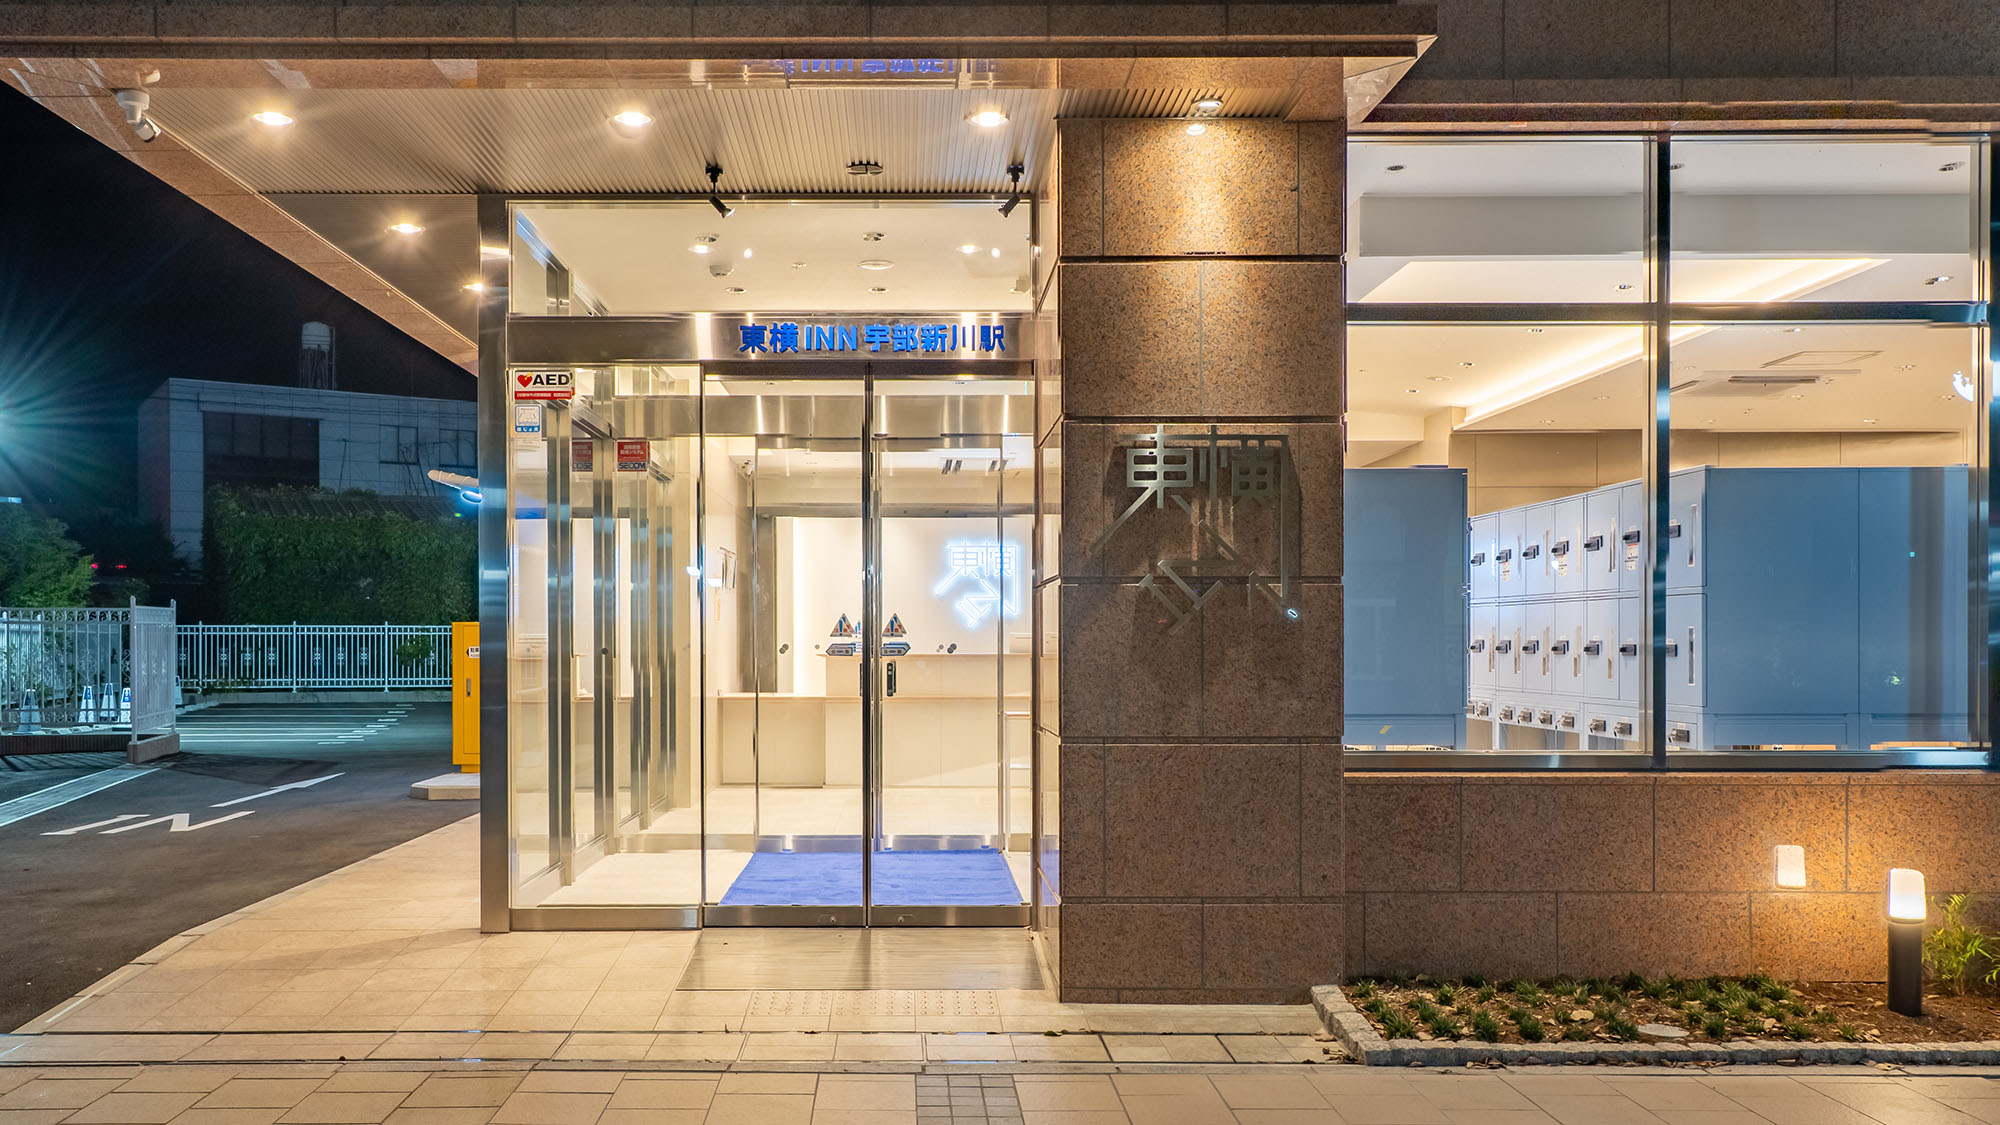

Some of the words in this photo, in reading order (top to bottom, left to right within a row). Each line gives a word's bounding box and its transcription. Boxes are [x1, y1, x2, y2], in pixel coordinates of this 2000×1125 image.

[805, 325, 858, 352] INN
[863, 322, 1006, 354] 宇部新川駅
[532, 374, 570, 386] AED
[618, 462, 646, 470] SECOM
[40, 811, 256, 836] IN
